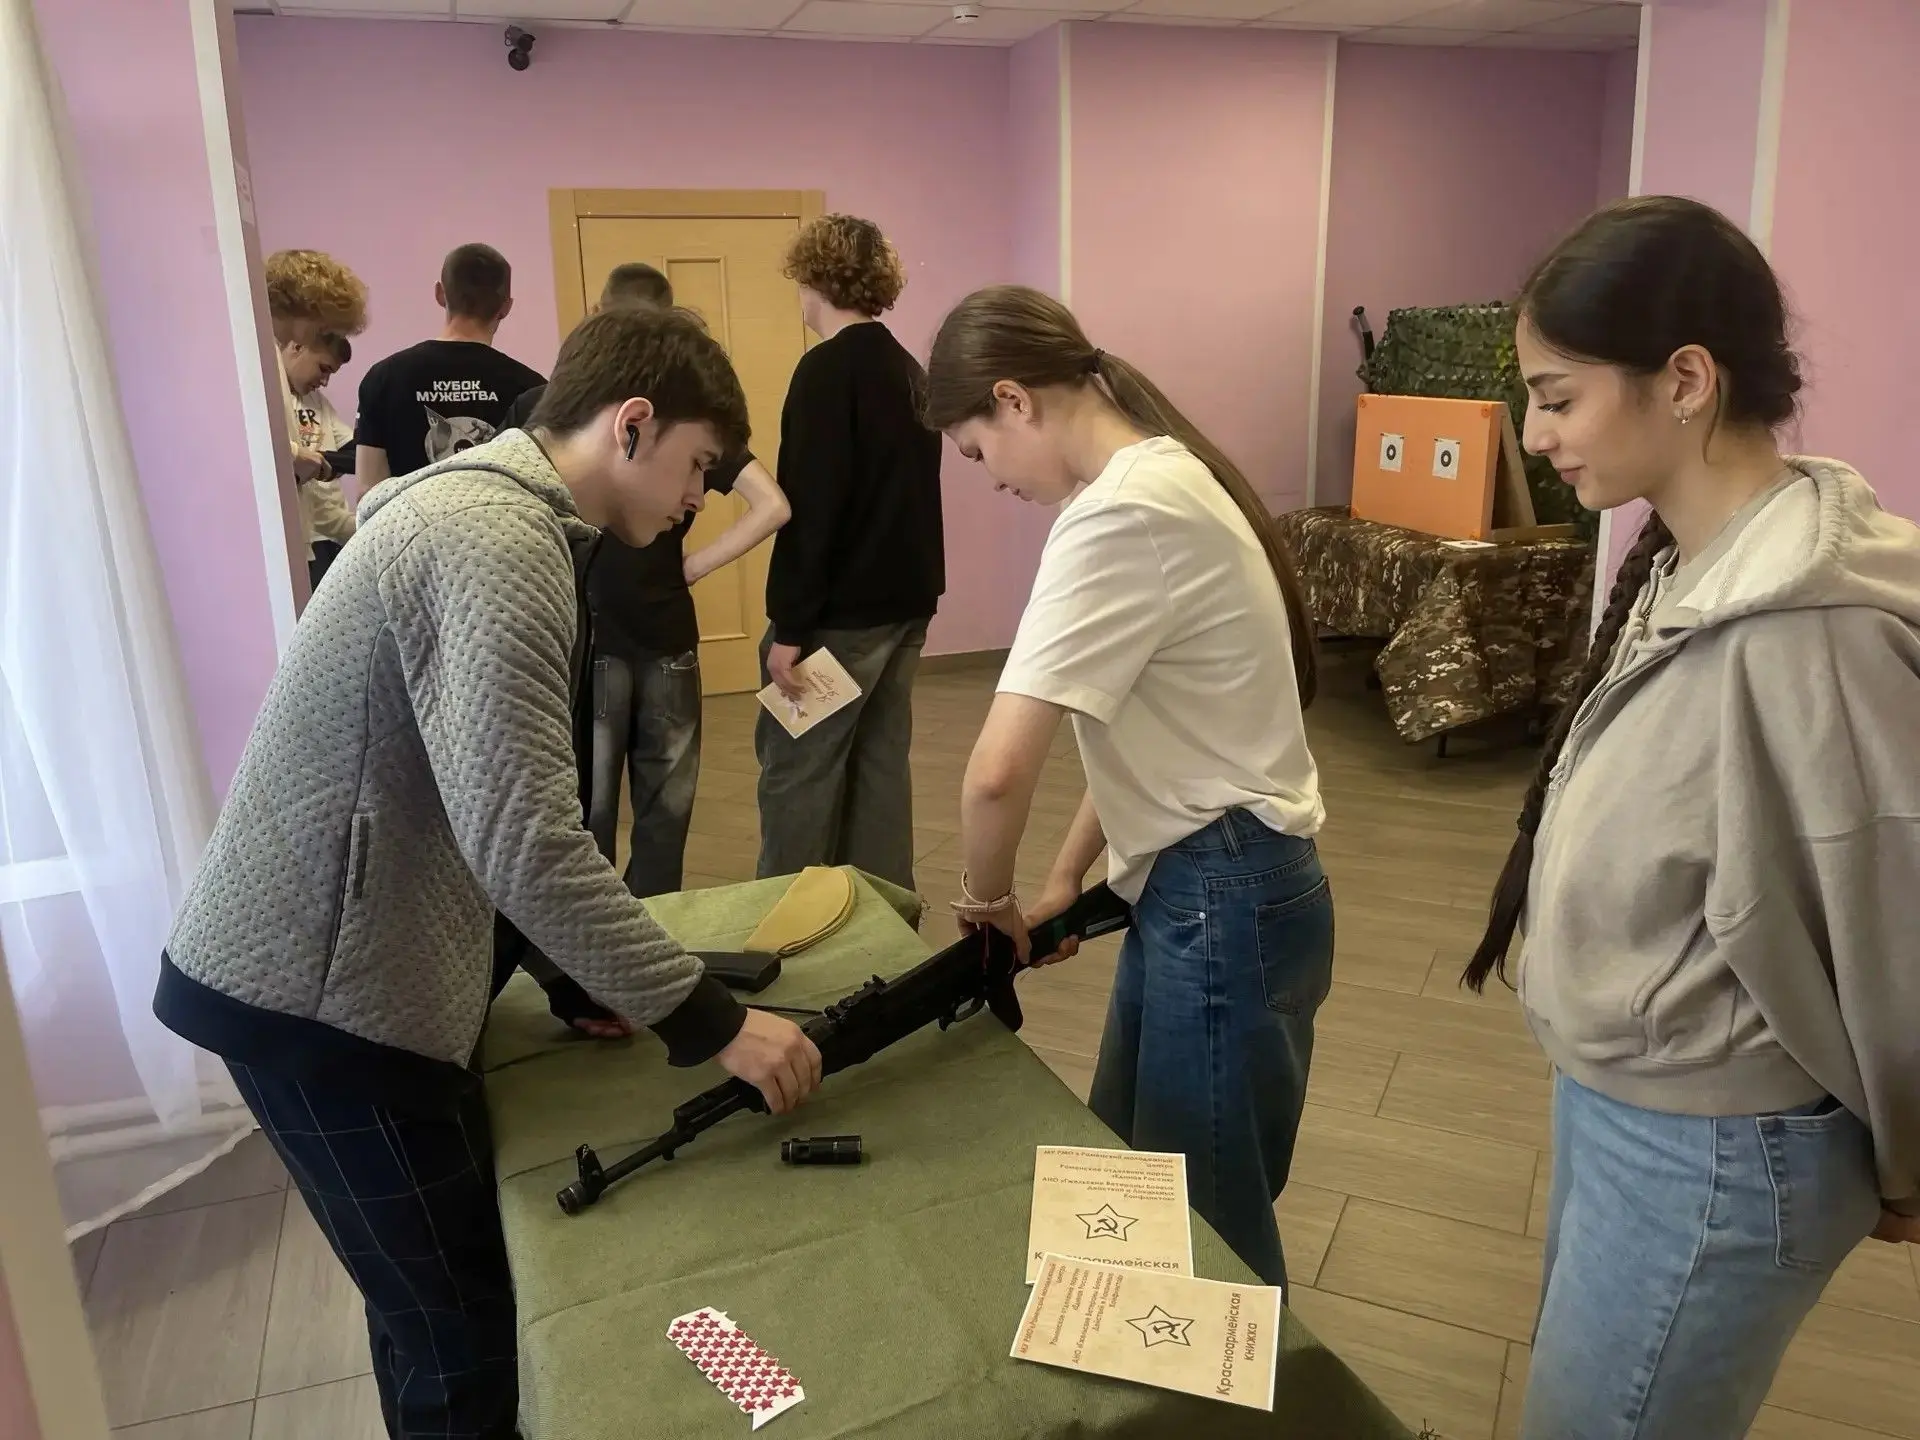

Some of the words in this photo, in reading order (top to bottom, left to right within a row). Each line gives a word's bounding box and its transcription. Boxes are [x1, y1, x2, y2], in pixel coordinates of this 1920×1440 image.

[433, 380, 481, 391] КУБОК
[416, 390, 499, 402] МУЖЕСТВА
[1216, 1292, 1241, 1396] Красноармейская
